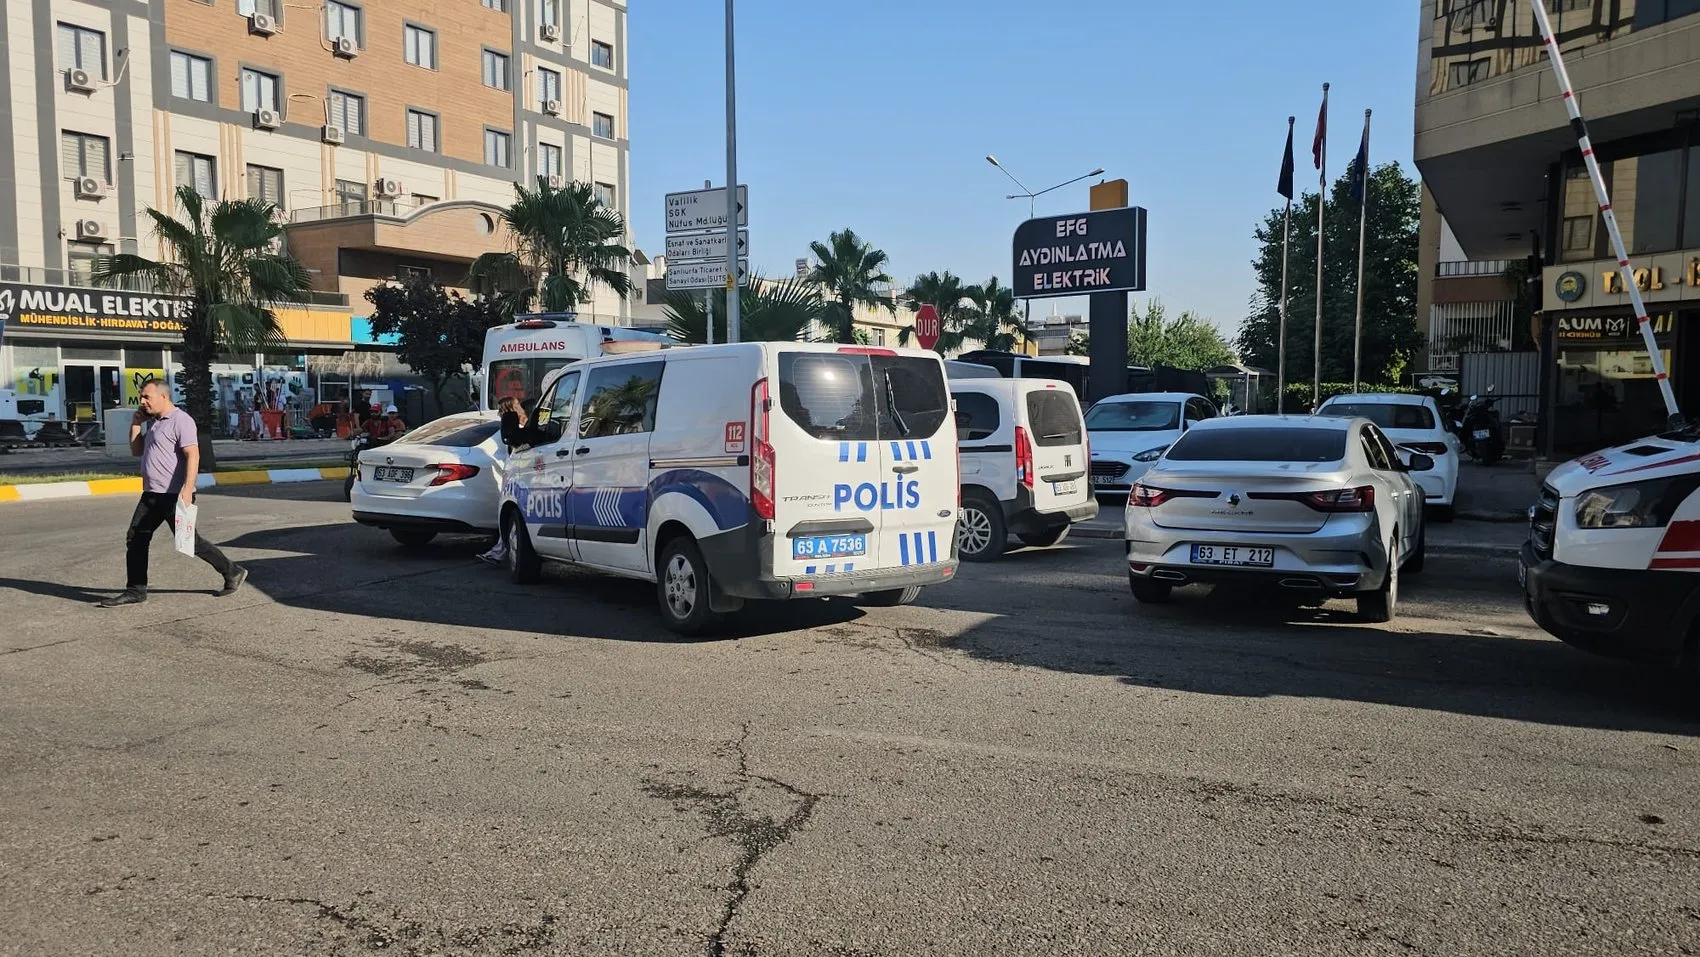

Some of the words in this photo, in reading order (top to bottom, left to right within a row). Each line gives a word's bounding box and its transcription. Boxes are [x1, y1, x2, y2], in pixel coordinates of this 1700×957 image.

[669, 196, 698, 206] Valilik
[669, 208, 687, 217] SGK
[669, 219, 693, 228] Nüfus
[1056, 218, 1087, 237] EFG
[668, 239, 686, 247] Esnaf
[695, 236, 727, 246] Sanatkarl
[1019, 240, 1127, 266] AYDINLATMA
[700, 265, 722, 274] Ticaret
[1034, 268, 1111, 290] ELEKTRİK
[19, 289, 98, 314] MUAL
[917, 319, 938, 336] DUR
[500, 341, 566, 353] AMBULANS
[728, 425, 743, 440] 112
[834, 473, 920, 512] POLİS
[527, 489, 562, 518] POLİS
[797, 541, 814, 554] 63
[817, 540, 828, 554] A
[831, 537, 863, 552] 7536
[1199, 547, 1213, 559] 63
[1223, 547, 1238, 560] ET
[1249, 549, 1271, 562] 212
